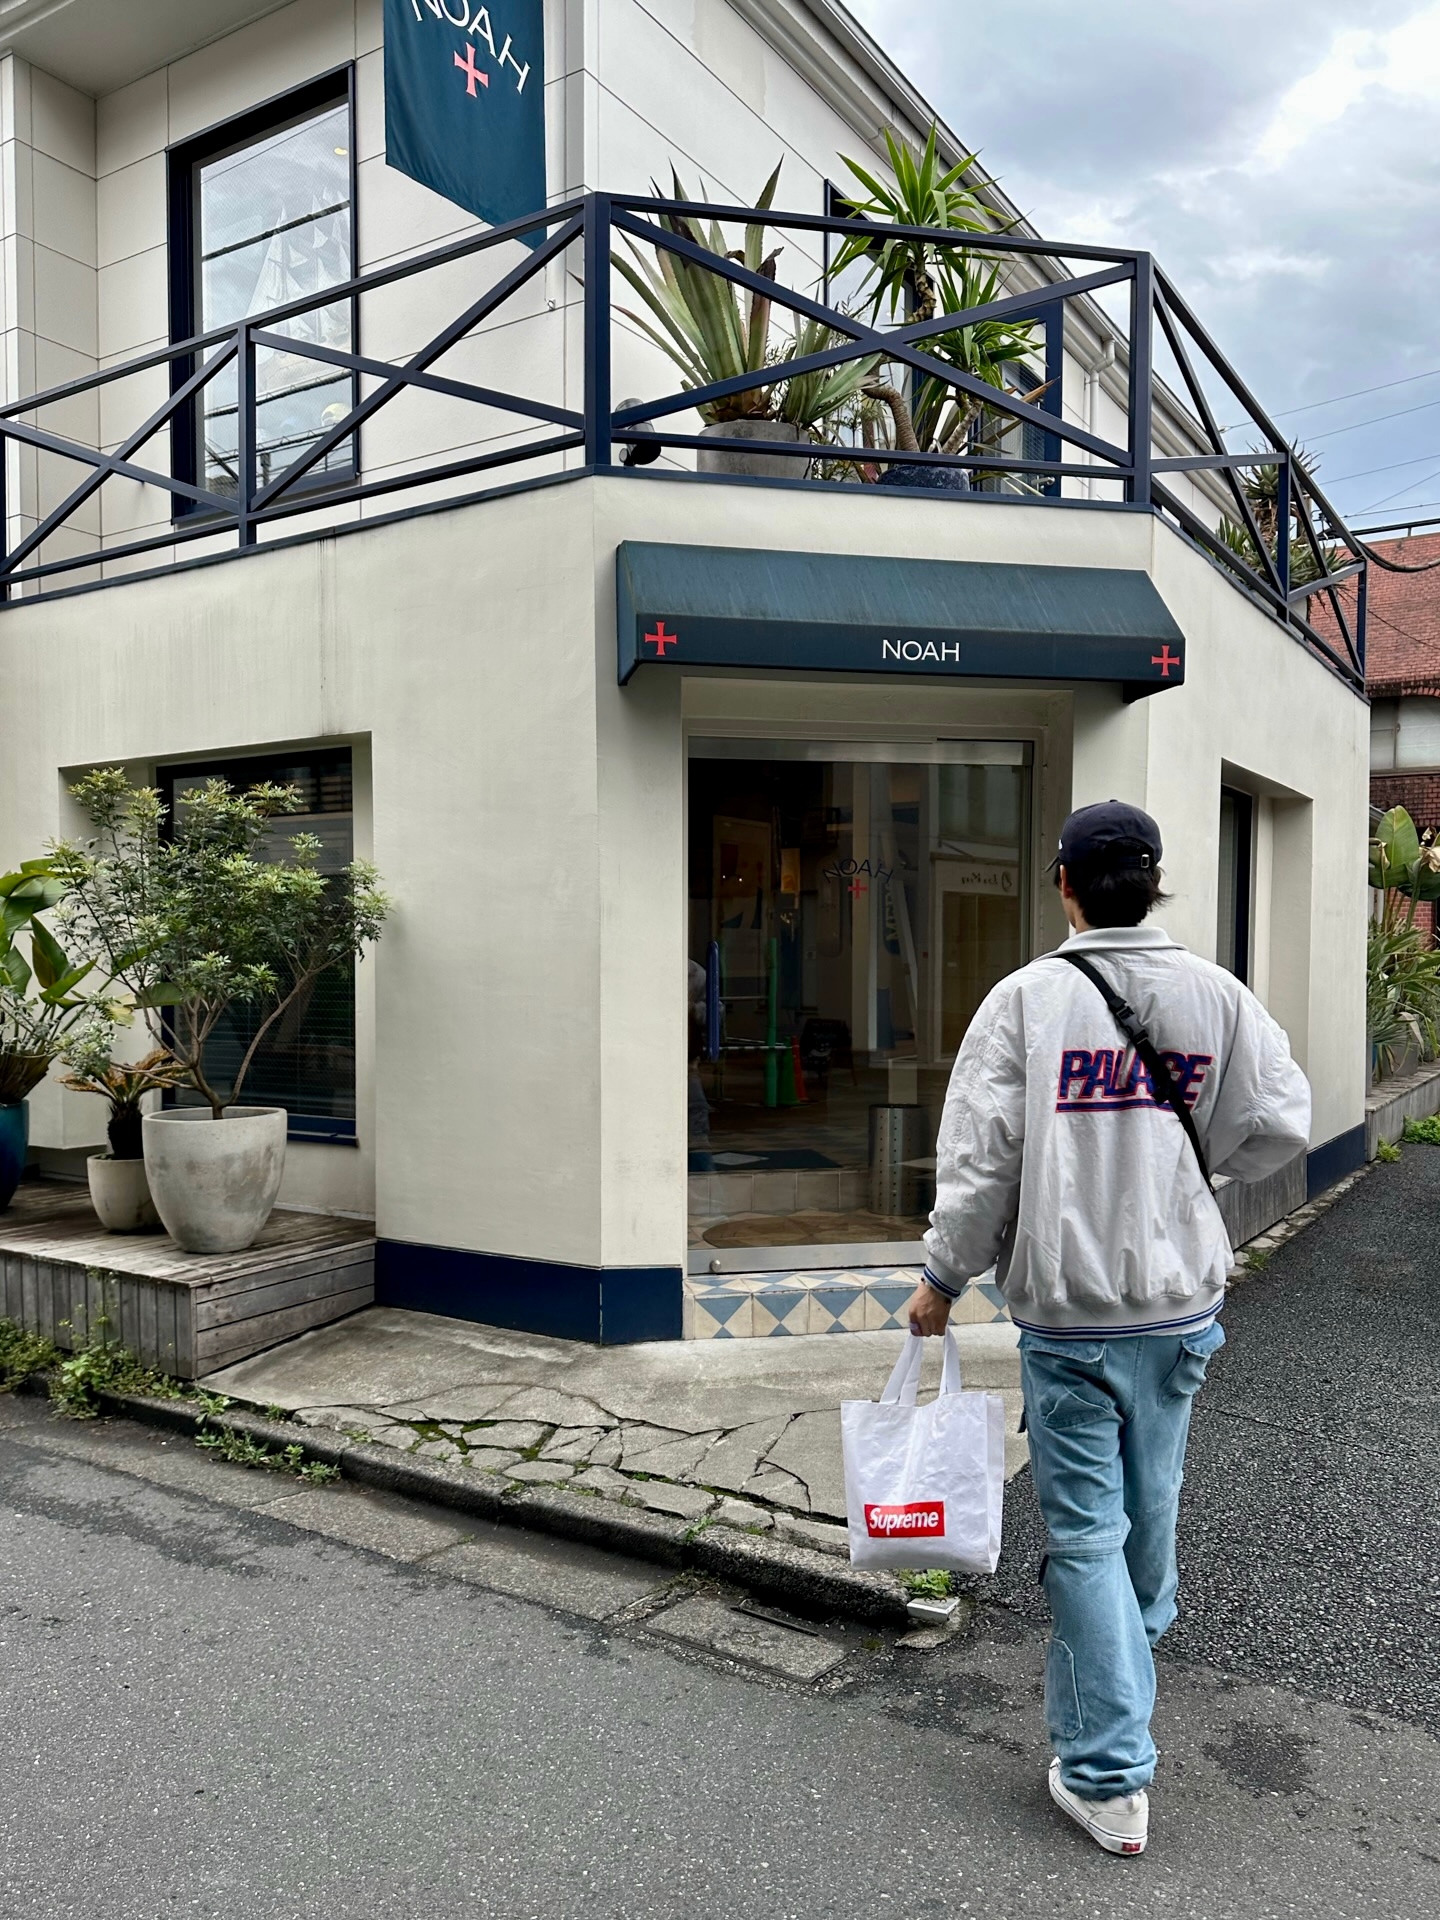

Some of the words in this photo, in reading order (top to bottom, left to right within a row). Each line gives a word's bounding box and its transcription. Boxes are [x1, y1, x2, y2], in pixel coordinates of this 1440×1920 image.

[882, 639, 960, 662] NOAH
[822, 858, 894, 884] NOAH
[869, 1507, 939, 1536] Supreme
